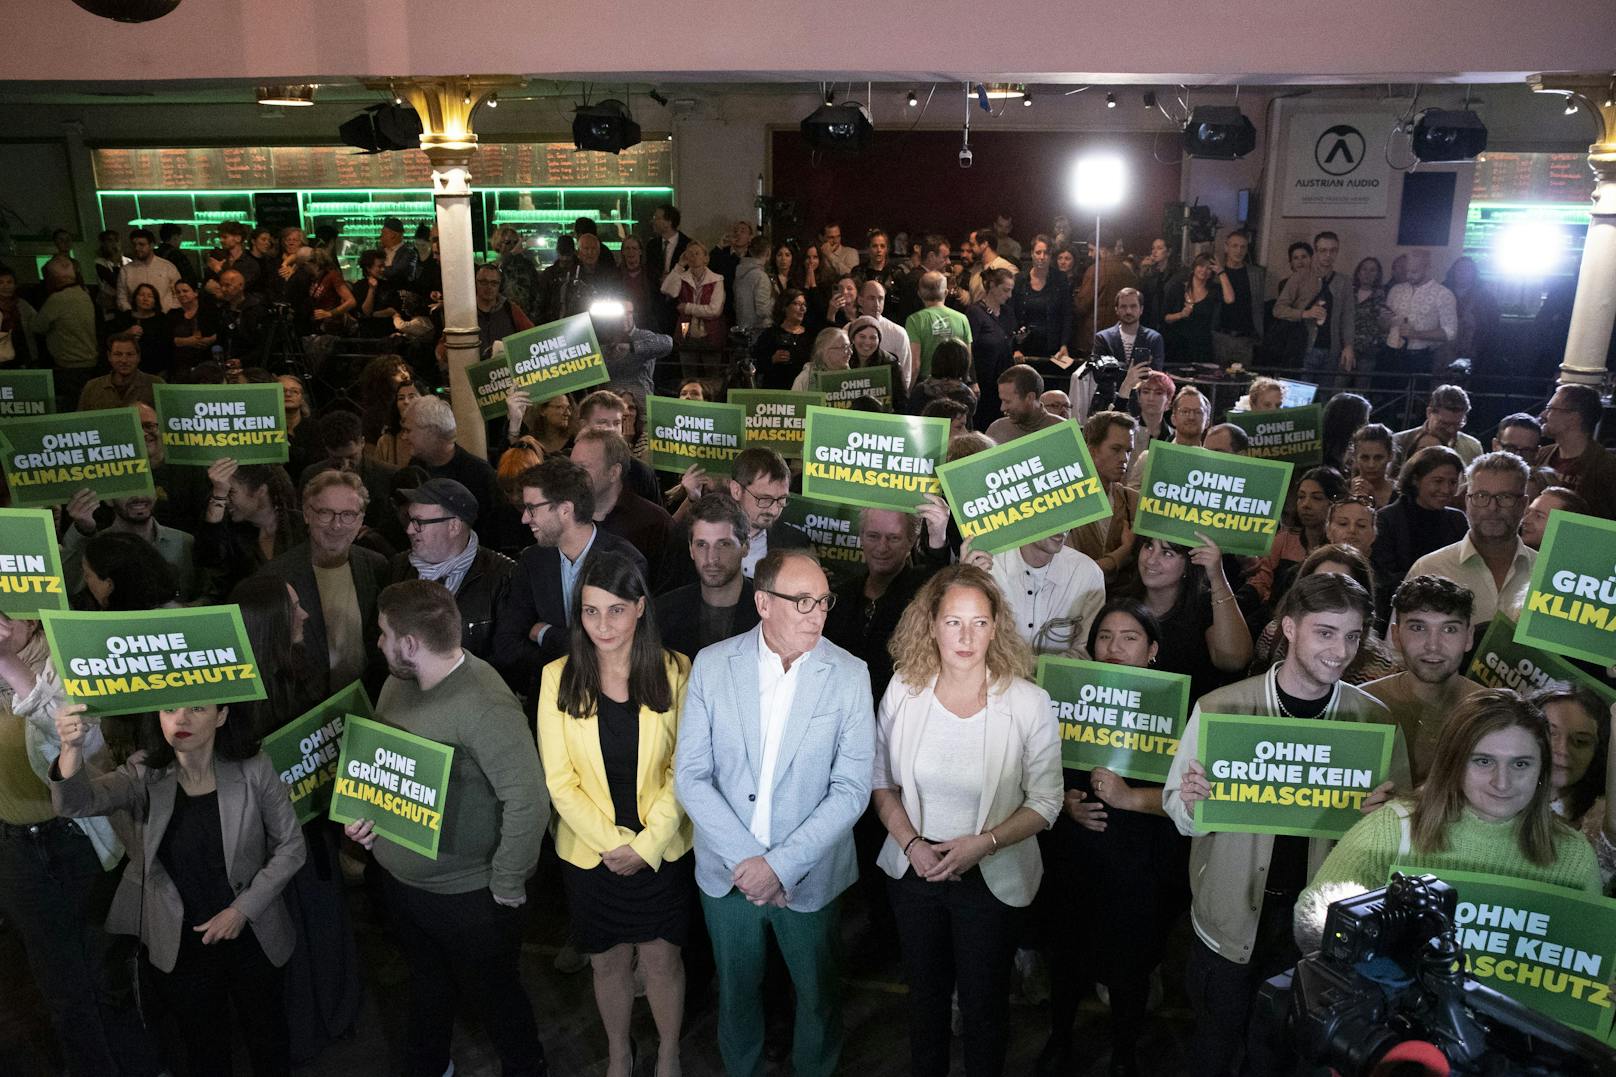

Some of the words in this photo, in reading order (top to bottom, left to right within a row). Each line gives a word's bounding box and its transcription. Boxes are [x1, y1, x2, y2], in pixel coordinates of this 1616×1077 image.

[1295, 179, 1343, 188] AUSTRIAN
[1347, 179, 1379, 188] AUDIO
[529, 336, 567, 355] OHNE
[512, 353, 602, 387] KLIMASCHUTZ
[515, 352, 558, 374] GRÜNE
[559, 342, 592, 361] KEIN
[489, 367, 510, 381] OHN
[841, 379, 870, 390] OHNE
[826, 389, 860, 401] GRÜNE
[1, 401, 45, 414] KEIN
[194, 402, 246, 416] OHNE
[756, 403, 795, 416] OHNE
[168, 415, 230, 431] GRÜNE
[233, 416, 276, 430] KEIN
[675, 415, 714, 431] OHNE
[745, 414, 781, 428] RÜNE
[784, 417, 806, 428] KEI
[1256, 421, 1294, 434] OHNE
[42, 430, 101, 450] OHNE
[162, 431, 285, 446] KLIMASCHUTZ
[655, 426, 700, 443] GRÜNE
[702, 432, 737, 447] KEIN
[848, 432, 905, 453] OHNE
[1247, 440, 1322, 457] IMASCHUTZ
[1248, 433, 1282, 446] RÜNE
[1284, 429, 1315, 443] KEIN
[14, 449, 85, 469] GRÜNE
[87, 443, 136, 462] KEIN
[815, 446, 883, 469] GRÜNE
[887, 455, 934, 475] KEIN
[8, 459, 148, 486] KLIMASCHUTZ
[805, 461, 941, 494] KLIMASCHUTZ
[985, 455, 1045, 490] OHNE
[1187, 469, 1246, 493] OHNE
[962, 481, 1033, 518] GRÜNE
[1032, 462, 1084, 493] KEIN
[1152, 481, 1222, 509] GRÜNE
[1224, 495, 1272, 516] KEIN
[960, 476, 1101, 538] KLIMASCHUTZ
[1139, 496, 1277, 534] KLIMASCHUTZ
[805, 514, 851, 532] OHNE
[835, 534, 861, 549] KEI
[0, 555, 45, 572] EIN
[106, 633, 188, 655] OHNE
[70, 654, 167, 676] GRÜNE
[170, 647, 238, 669] KEIN
[64, 664, 256, 697] KLIMASCHUTZ
[1080, 684, 1141, 709] OHNE
[1121, 710, 1173, 734] KEIN
[300, 717, 344, 754] OHNE
[1058, 722, 1181, 756] IMASCHUTZ
[280, 743, 338, 784] GRÜNE
[374, 747, 416, 777] OHNE
[1255, 741, 1332, 764] OHNE
[347, 759, 398, 792] GRÜNE
[400, 777, 436, 807] KEIN
[1212, 758, 1303, 783] GRÜNE
[1308, 766, 1372, 789] KEIN
[336, 776, 441, 831] KLIMASCHUTZ
[1454, 902, 1550, 936] OHNE
[1515, 936, 1602, 977] KEIN
